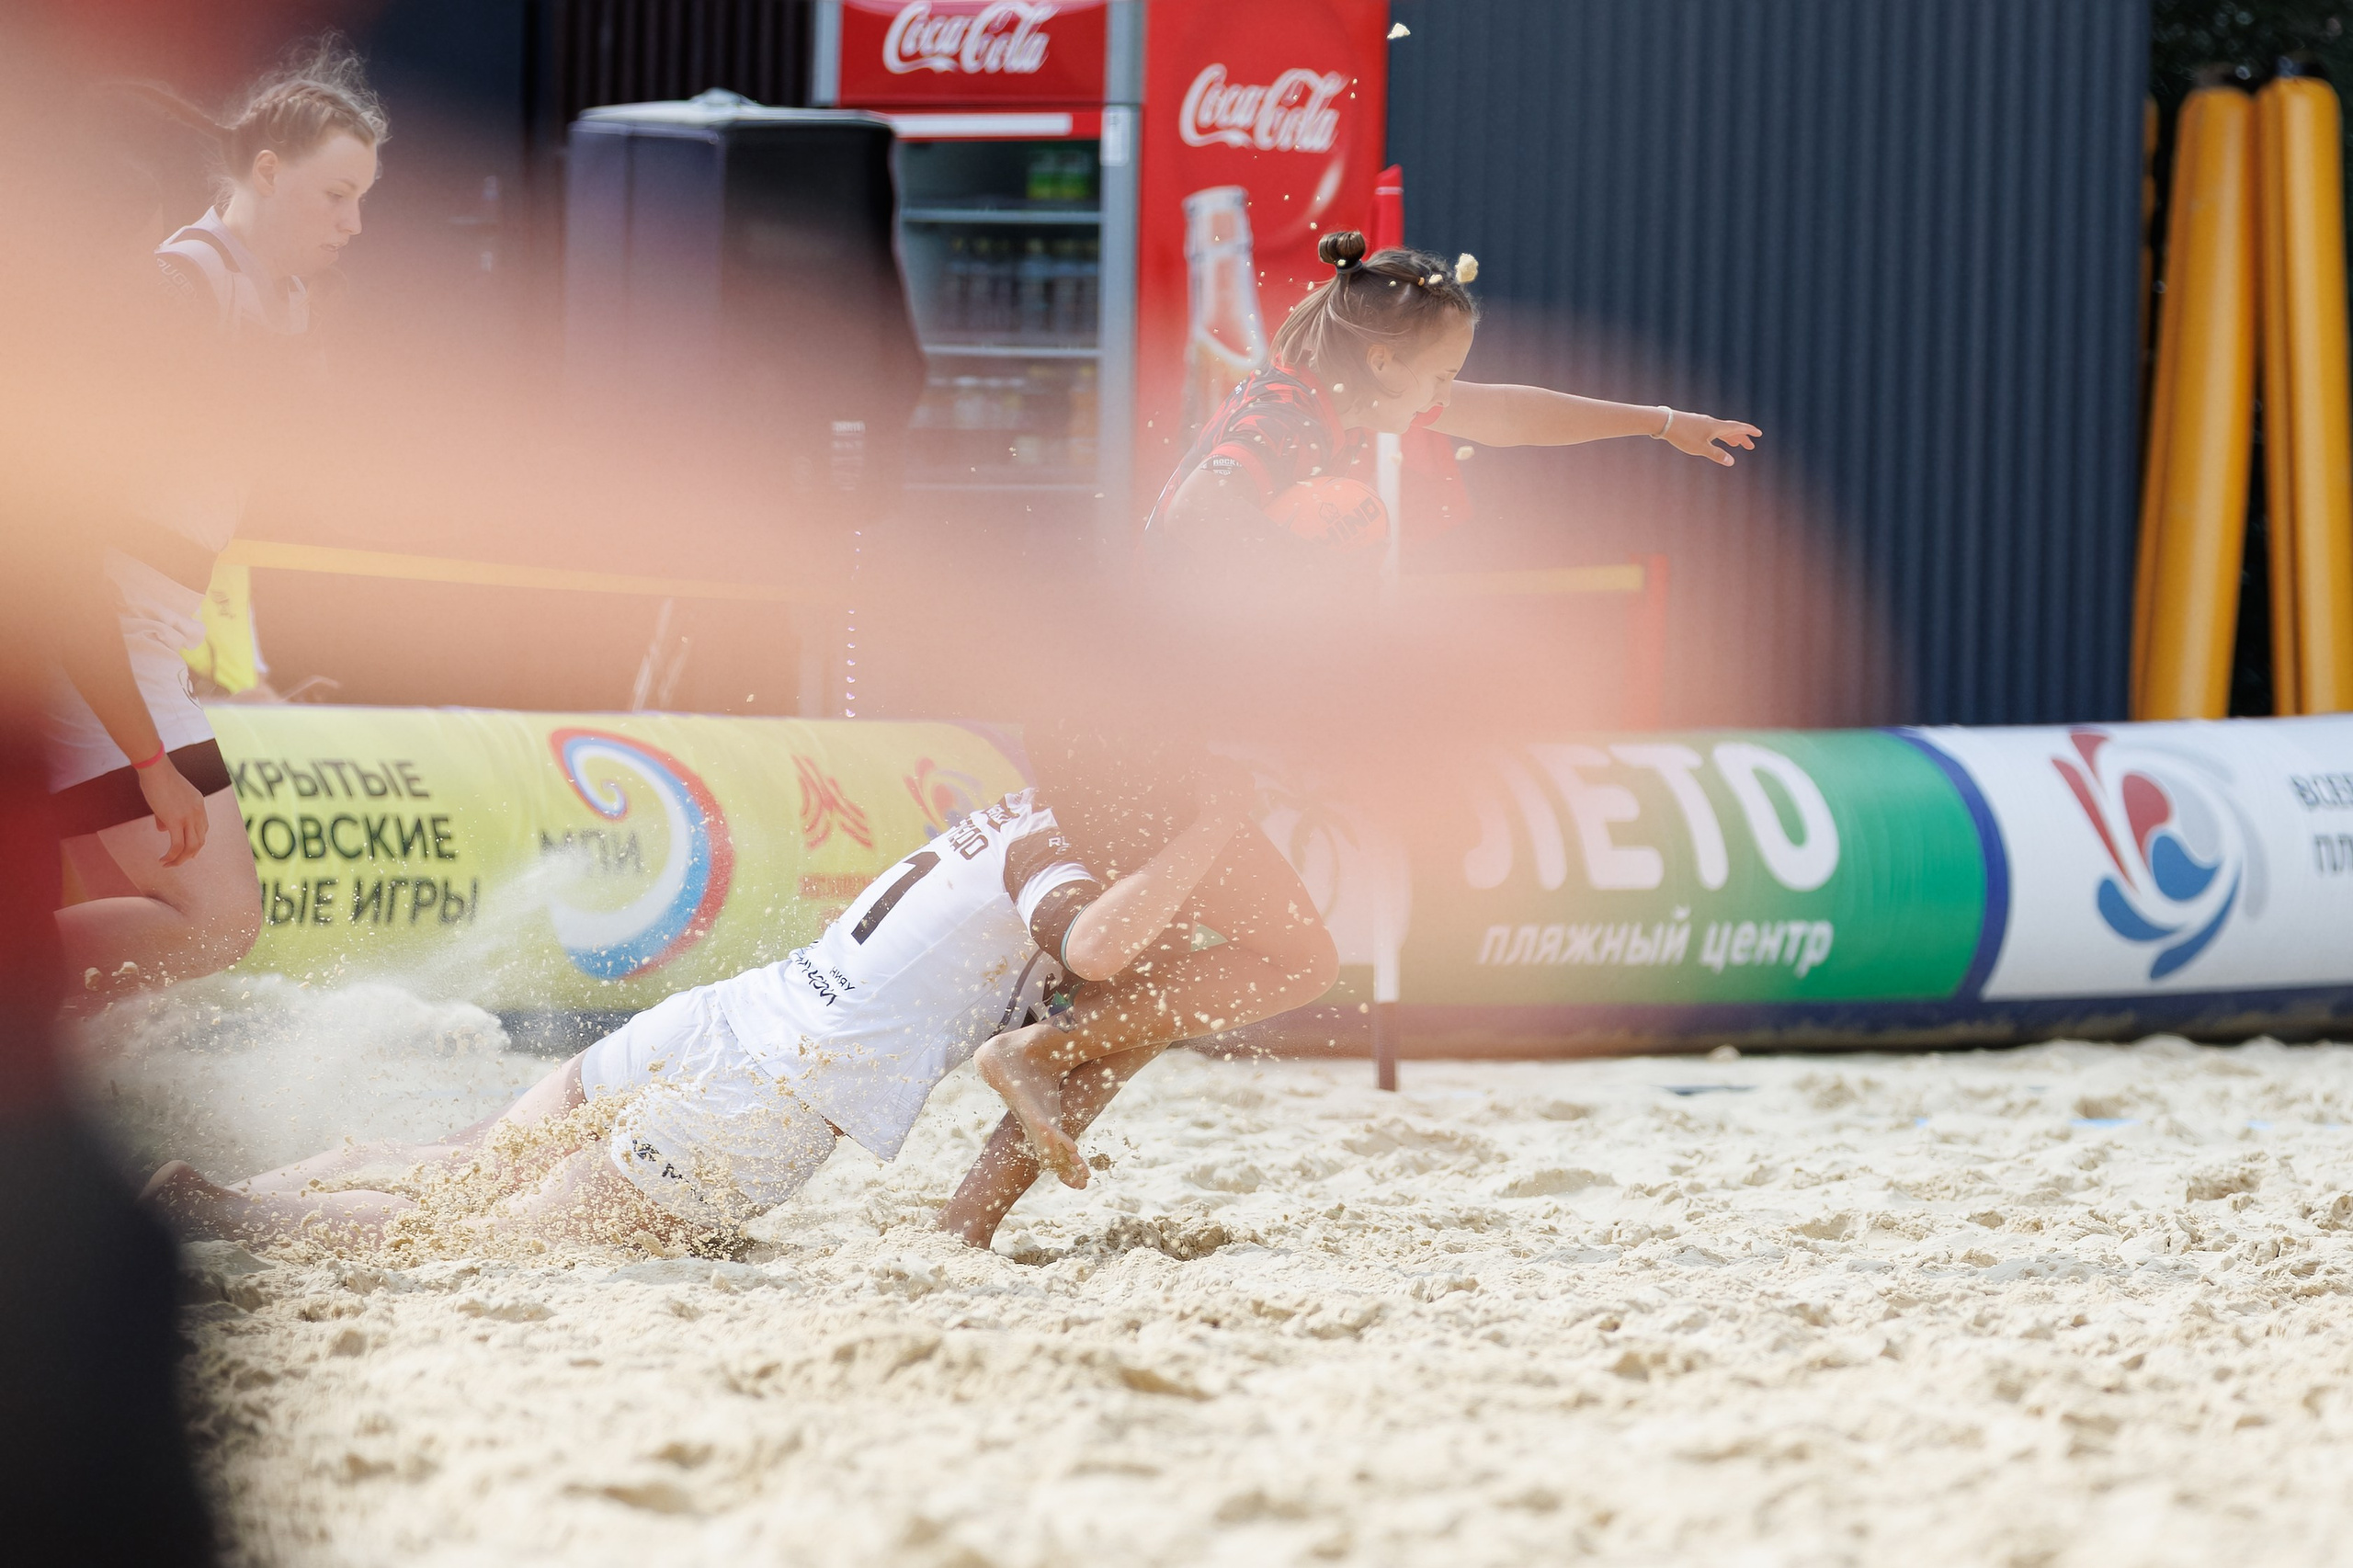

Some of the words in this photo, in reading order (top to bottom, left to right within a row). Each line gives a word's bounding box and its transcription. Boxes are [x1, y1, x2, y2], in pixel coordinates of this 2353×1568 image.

[245, 813, 457, 861] ОВСКИЕ
[1463, 741, 1840, 892] ЛЕТО
[348, 876, 480, 926] ИГРЫ
[850, 850, 941, 946] 1
